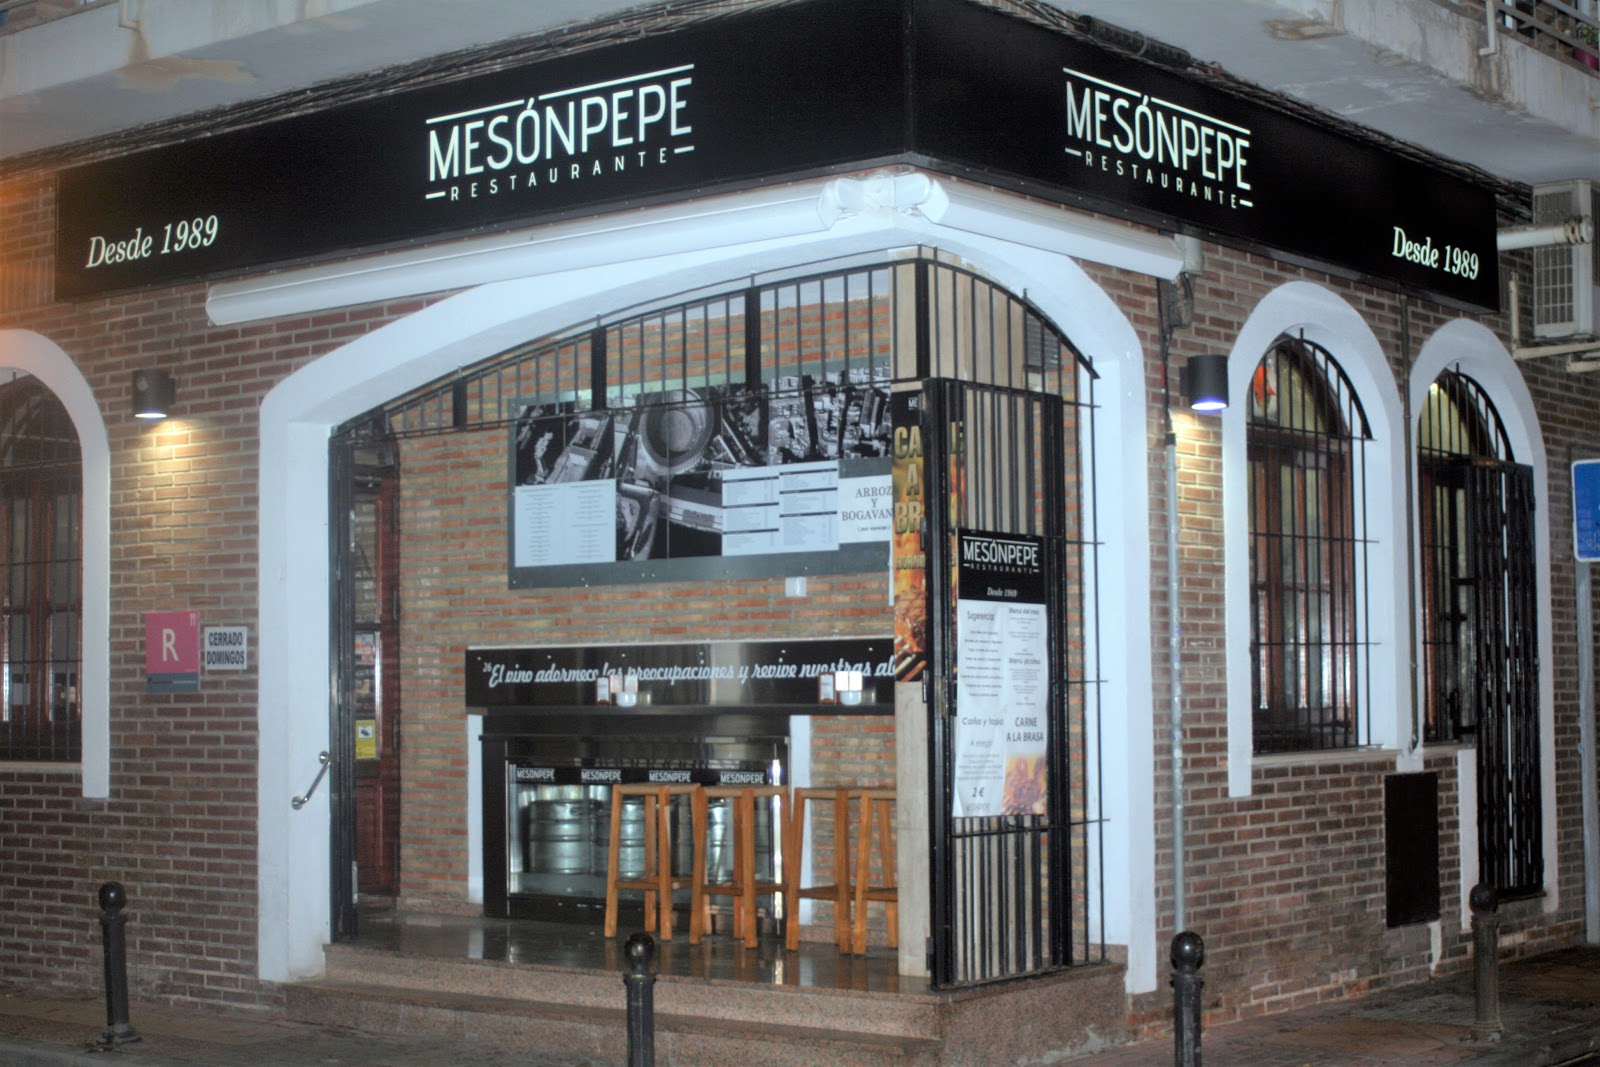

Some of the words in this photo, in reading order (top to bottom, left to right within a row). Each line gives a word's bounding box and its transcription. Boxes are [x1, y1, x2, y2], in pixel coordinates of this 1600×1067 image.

[429, 77, 692, 182] MESÓNPEPE
[1066, 80, 1251, 191] MESÓNPEPE
[450, 147, 667, 201] RESTAURANTE
[1085, 150, 1237, 209] RESTAURANTE
[86, 227, 153, 268] Desde
[160, 214, 219, 255] 1989
[1391, 226, 1439, 269] Desde
[1443, 244, 1479, 280] 1989
[855, 485, 893, 498] ARROZ
[870, 498, 878, 509] Y
[963, 540, 1039, 567] MESÓNPEPE
[970, 564, 1033, 574] RESTAURANTE
[986, 586, 1003, 597] Desde
[1003, 588, 1018, 598] 1989
[162, 628, 179, 662] R
[208, 631, 243, 647] CERRADO
[206, 650, 245, 665] DOMINGOS
[488, 664, 506, 689] El
[505, 663, 533, 683] vino
[627, 658, 734, 687] preocupaciones
[737, 664, 749, 685] y
[751, 657, 798, 679] revive
[1014, 717, 1038, 727] CARNE
[1006, 732, 1011, 742] A
[1012, 732, 1021, 742] LA
[1023, 731, 1044, 742] BRASA
